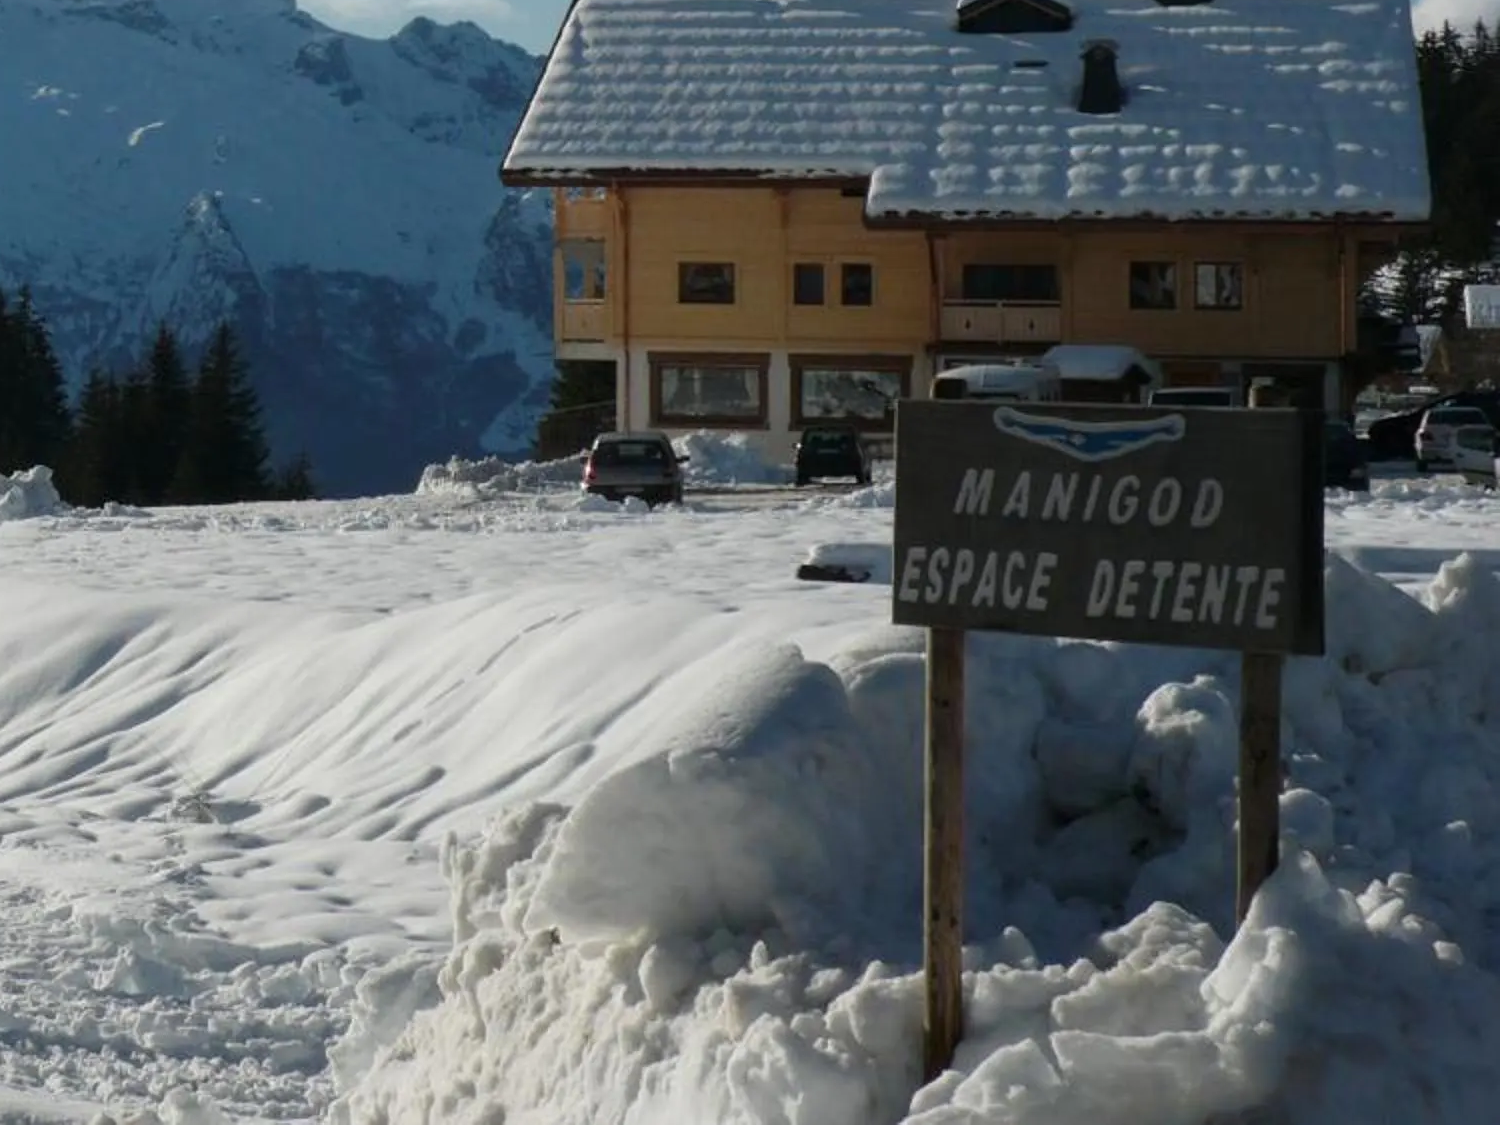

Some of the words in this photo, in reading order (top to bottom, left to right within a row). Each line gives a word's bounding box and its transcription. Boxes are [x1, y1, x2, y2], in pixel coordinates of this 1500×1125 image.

[954, 468, 1224, 528] MANIGOD
[899, 546, 1058, 611] ESPACE
[1086, 559, 1285, 629] DETENTE
